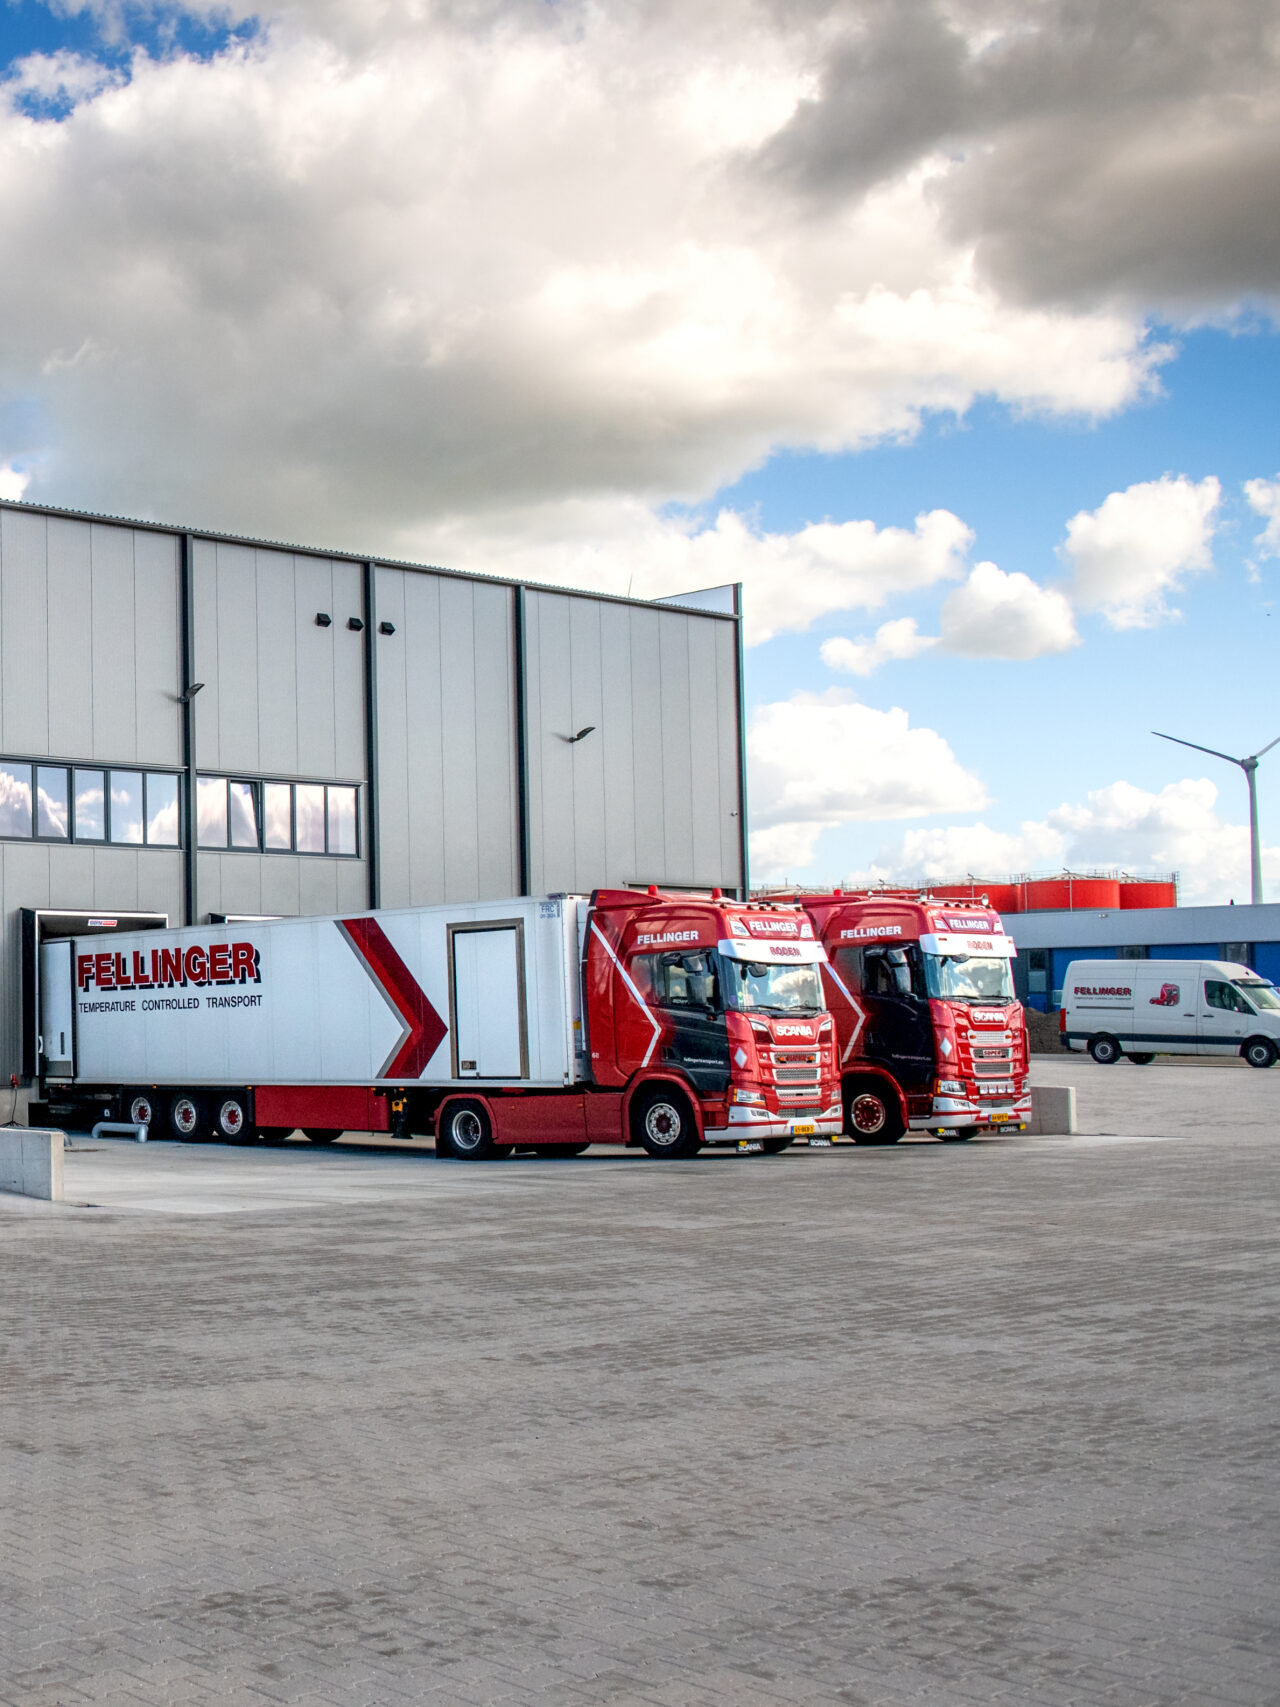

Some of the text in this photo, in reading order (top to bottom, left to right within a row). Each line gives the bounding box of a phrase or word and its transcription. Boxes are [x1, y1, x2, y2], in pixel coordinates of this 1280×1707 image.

[749, 920, 798, 932] FELLINGER
[949, 919, 989, 930] FELLINGER
[637, 930, 699, 945] FELLINGER
[840, 925, 902, 939] FELLINGER
[77, 942, 262, 992] FELLINGER
[1074, 986, 1132, 996] FELLINGER
[78, 994, 263, 1013] TEMPERATURE CONTROLLED TRANSPORT
[973, 1011, 1005, 1022] SCANIA
[775, 1025, 813, 1037] SCANIA
